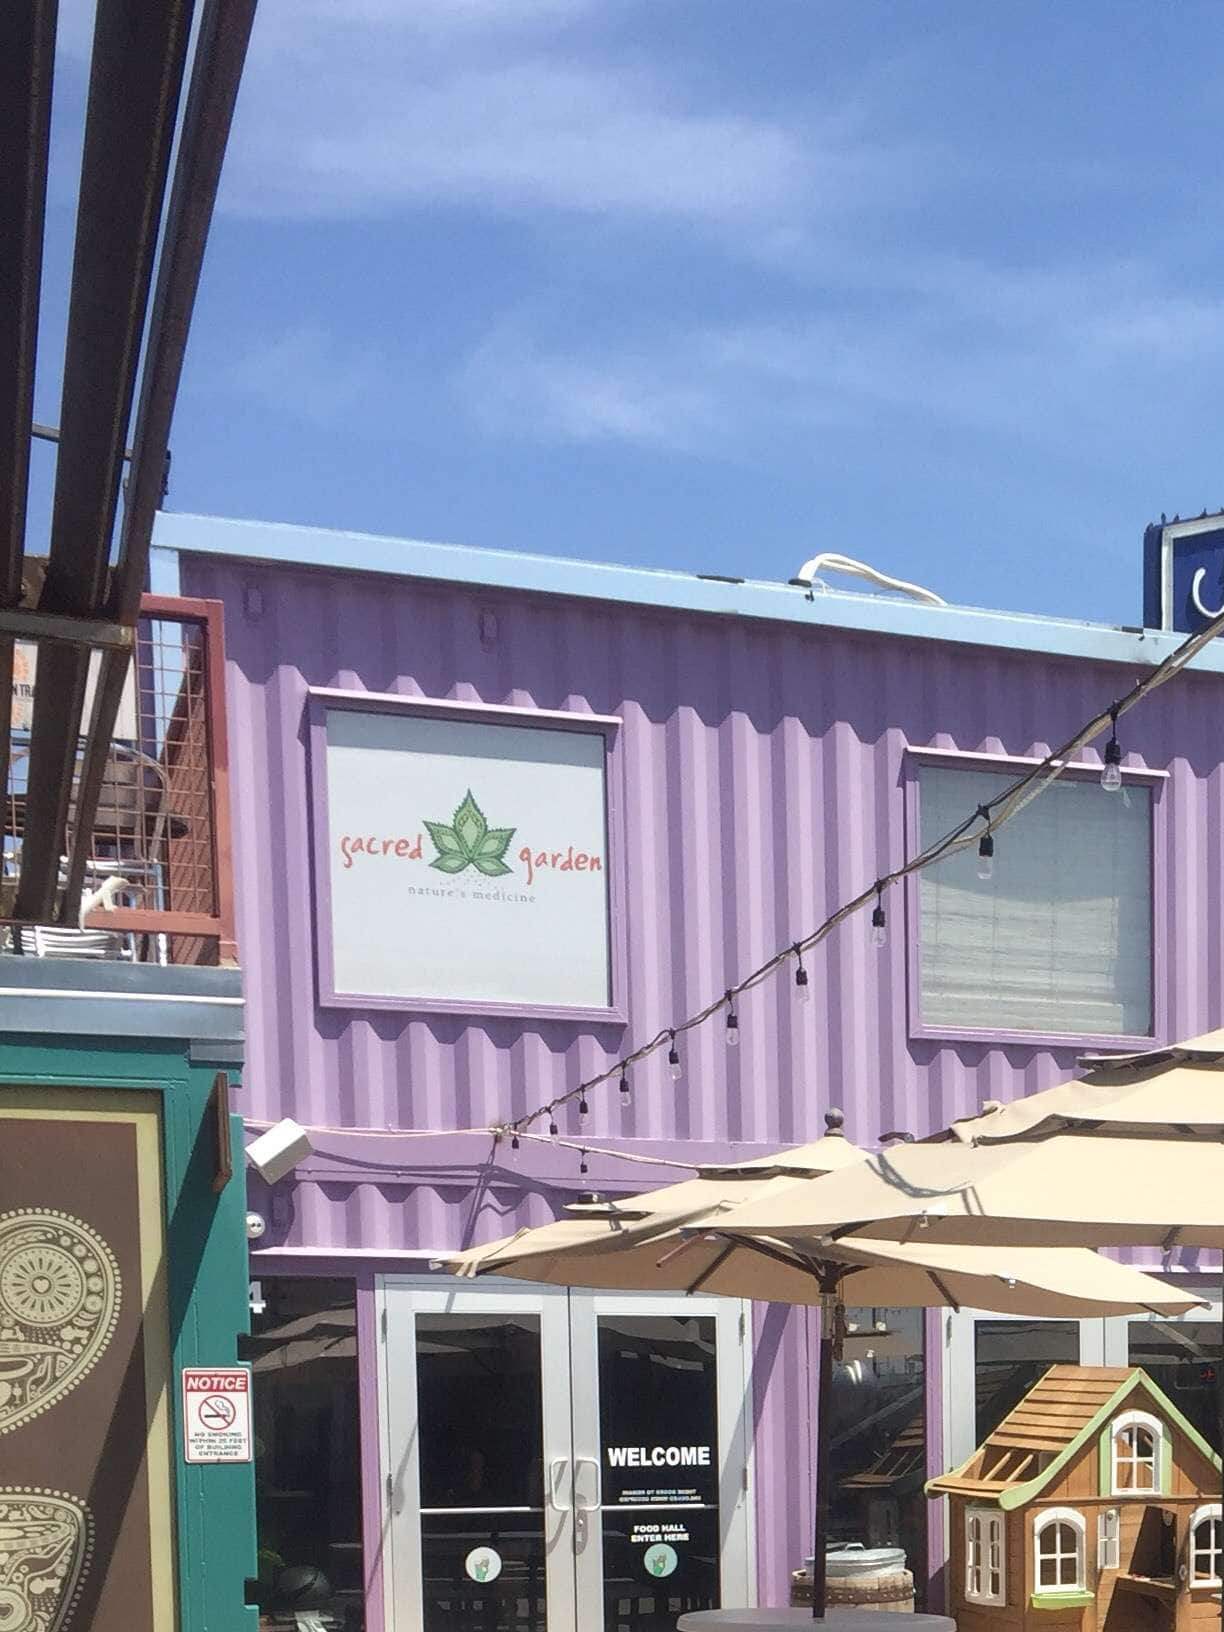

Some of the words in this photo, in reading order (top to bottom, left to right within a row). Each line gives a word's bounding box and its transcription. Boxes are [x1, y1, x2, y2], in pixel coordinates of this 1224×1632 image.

[340, 834, 423, 868] sacred
[519, 847, 602, 885] garden
[408, 885, 466, 899] nature's
[472, 890, 536, 903] medicine
[187, 1377, 247, 1390] NOTICE
[607, 1446, 711, 1467] WELCOME
[633, 1525, 660, 1533] FOOD
[661, 1524, 686, 1532] HALL
[630, 1534, 662, 1542] ENTER
[664, 1533, 690, 1541] HERE
